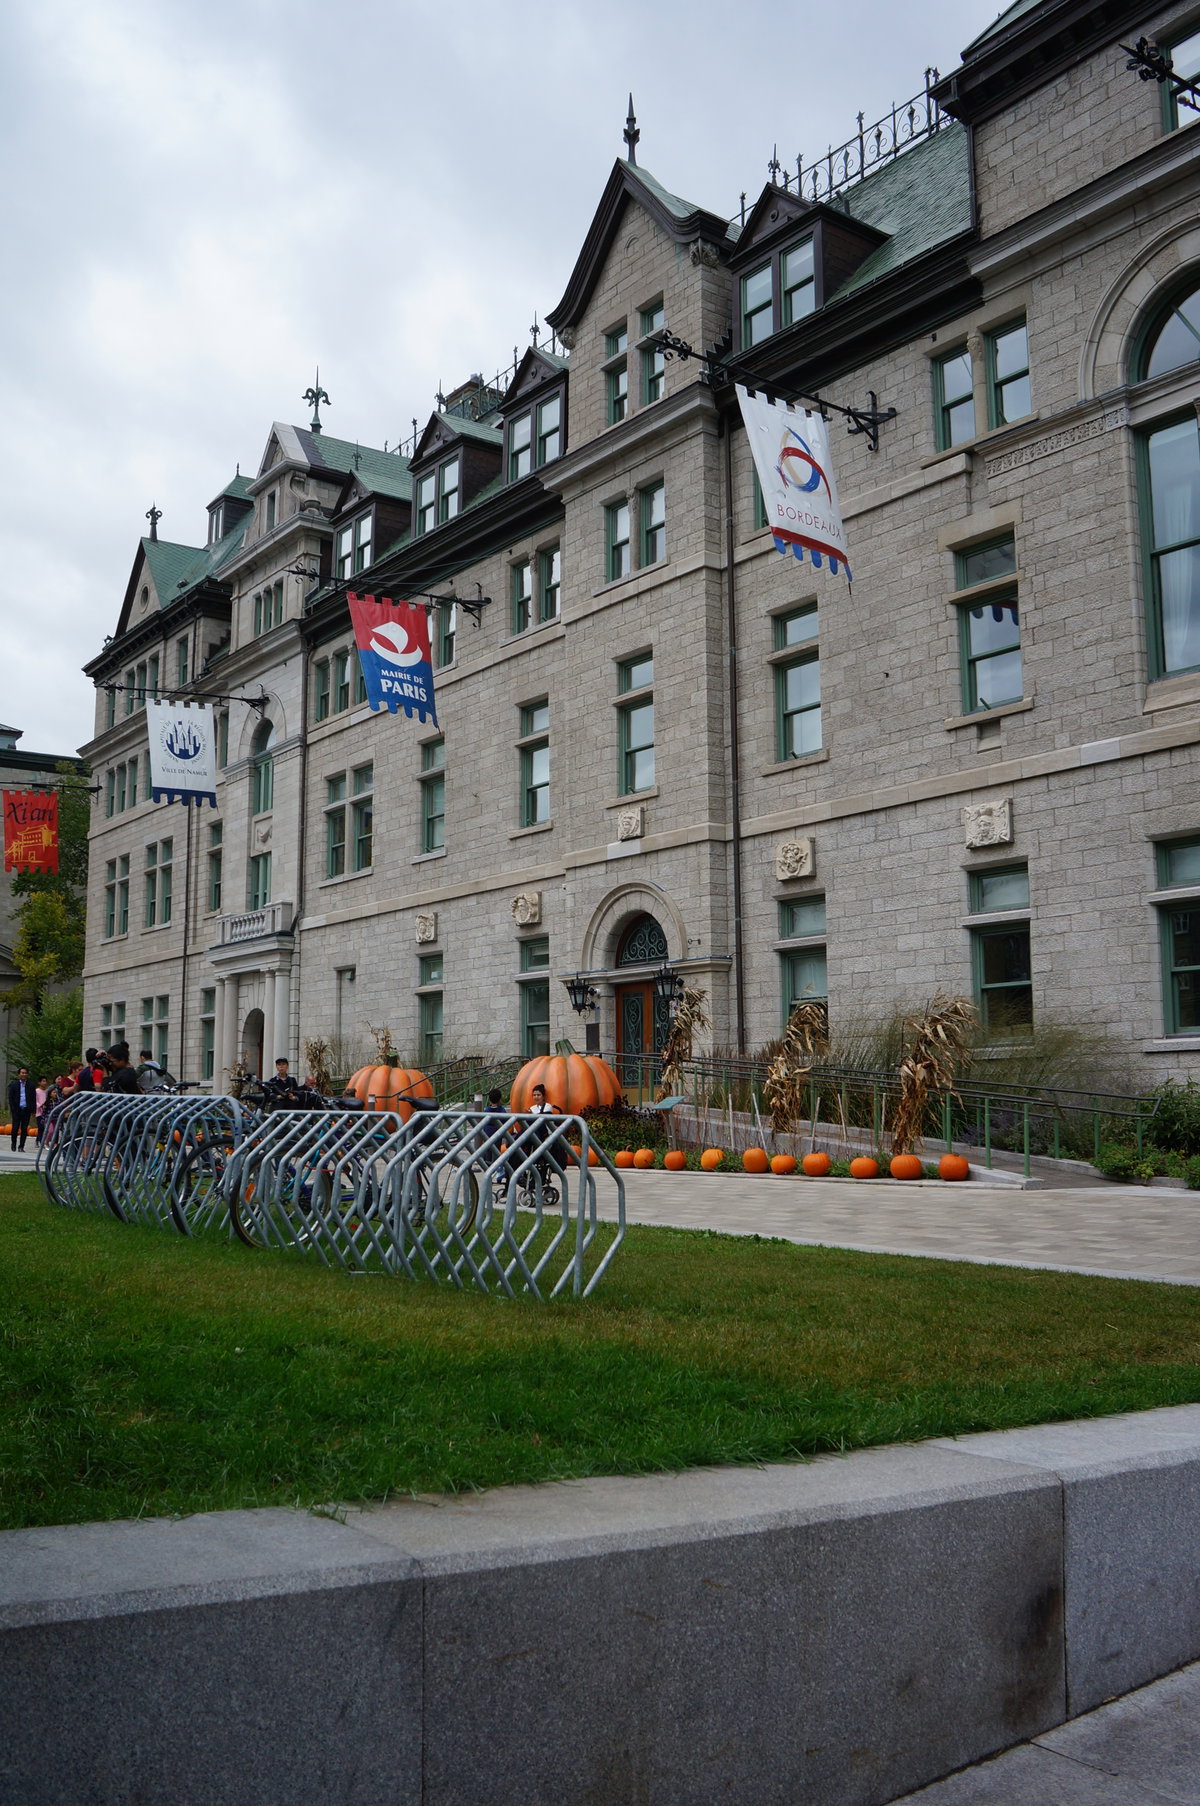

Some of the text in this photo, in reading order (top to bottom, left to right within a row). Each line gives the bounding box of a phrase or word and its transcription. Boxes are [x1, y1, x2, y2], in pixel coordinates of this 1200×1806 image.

[777, 503, 842, 541] BORDEAUX
[380, 669, 425, 685] MAIRIE DE
[380, 678, 428, 702] PARIS
[6, 802, 54, 825] Xi'an
